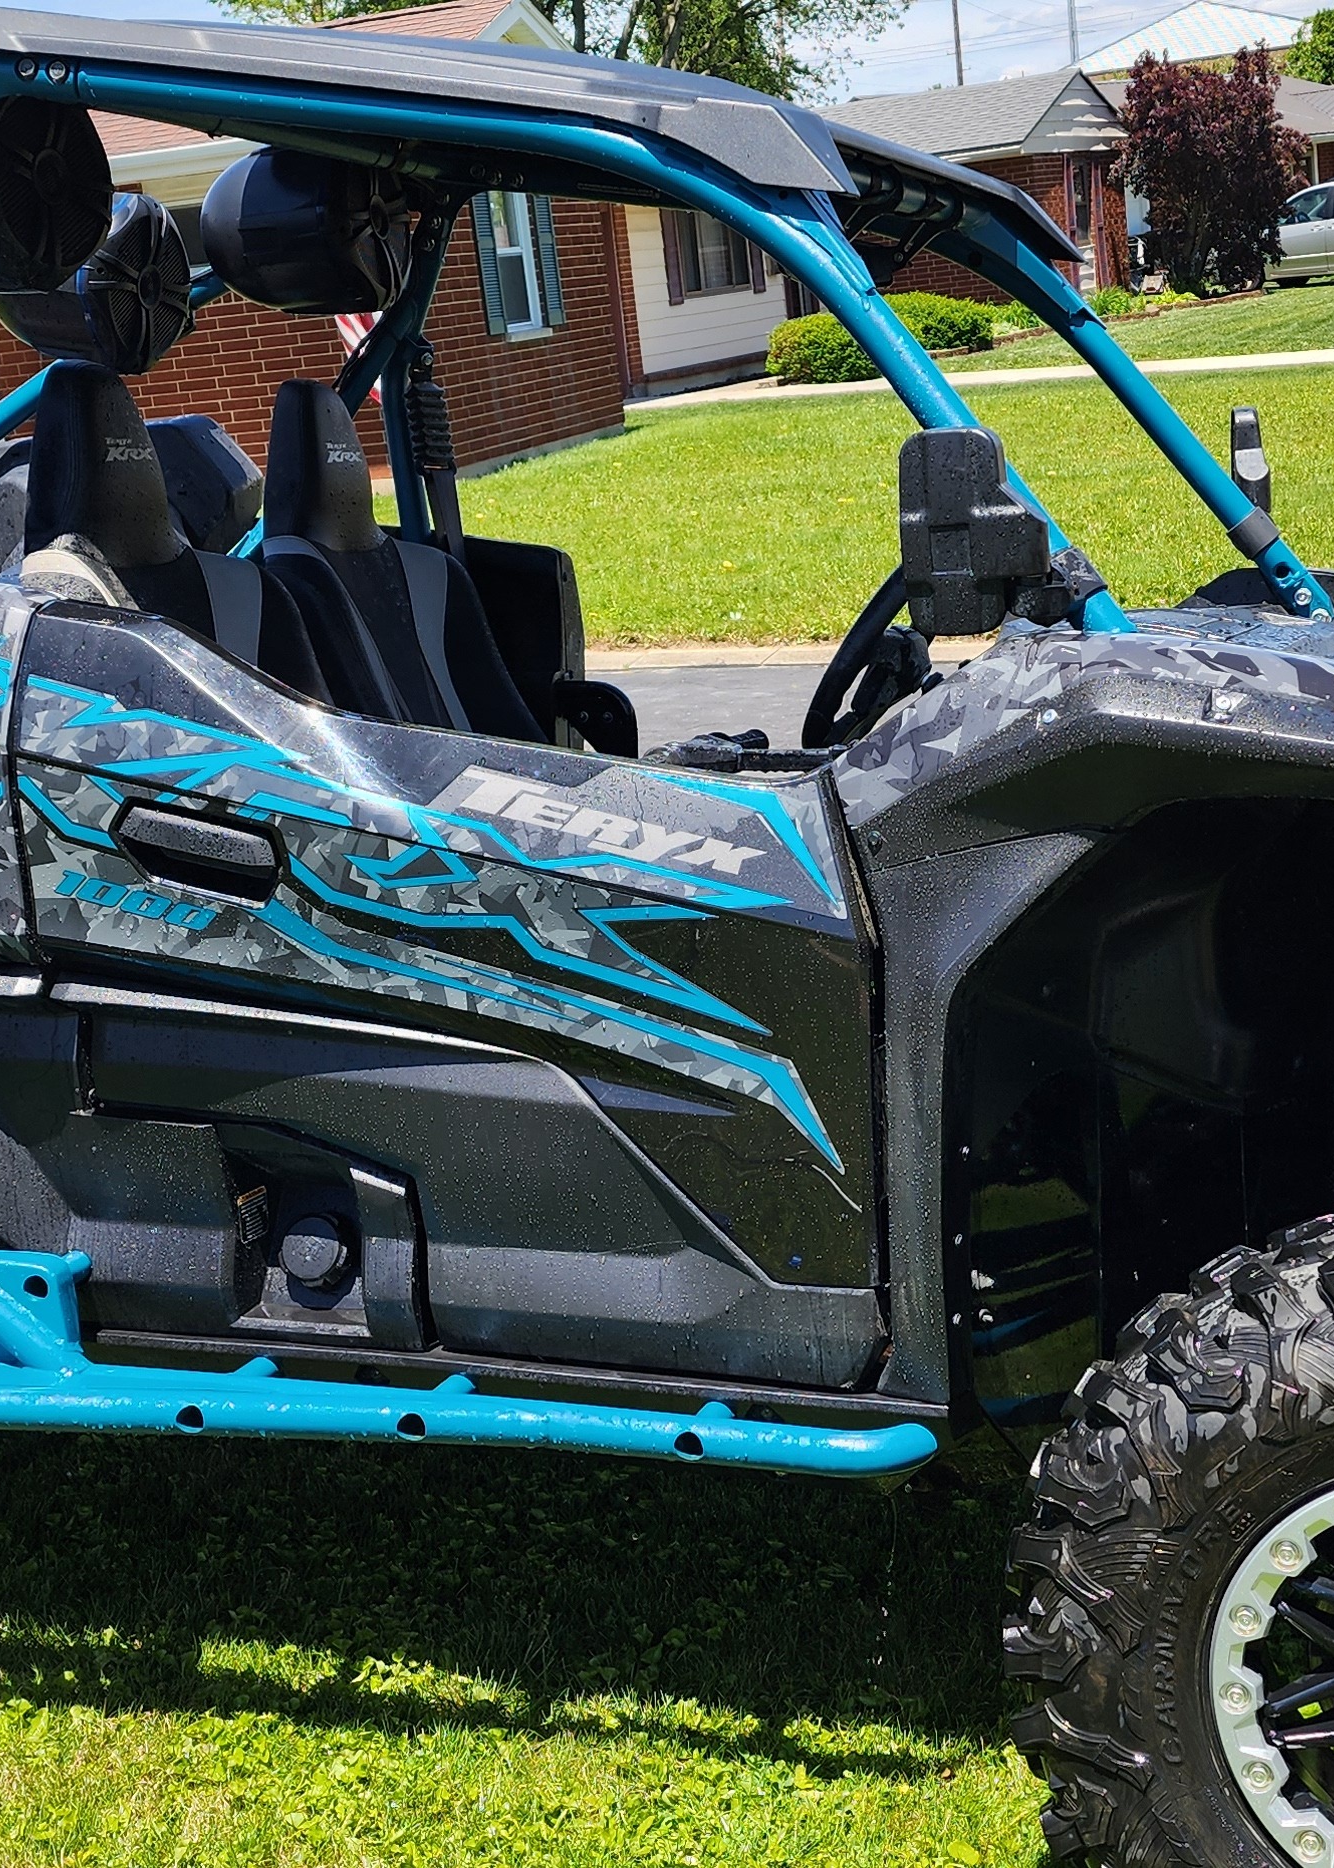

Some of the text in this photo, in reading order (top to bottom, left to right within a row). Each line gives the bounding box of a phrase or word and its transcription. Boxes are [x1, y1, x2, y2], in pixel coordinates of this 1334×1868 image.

[105, 446, 154, 461] KRX
[327, 450, 362, 463] KRX
[459, 766, 767, 875] TERYX
[54, 869, 217, 931] 1000
[1153, 1498, 1244, 1764] CARNIVORE
